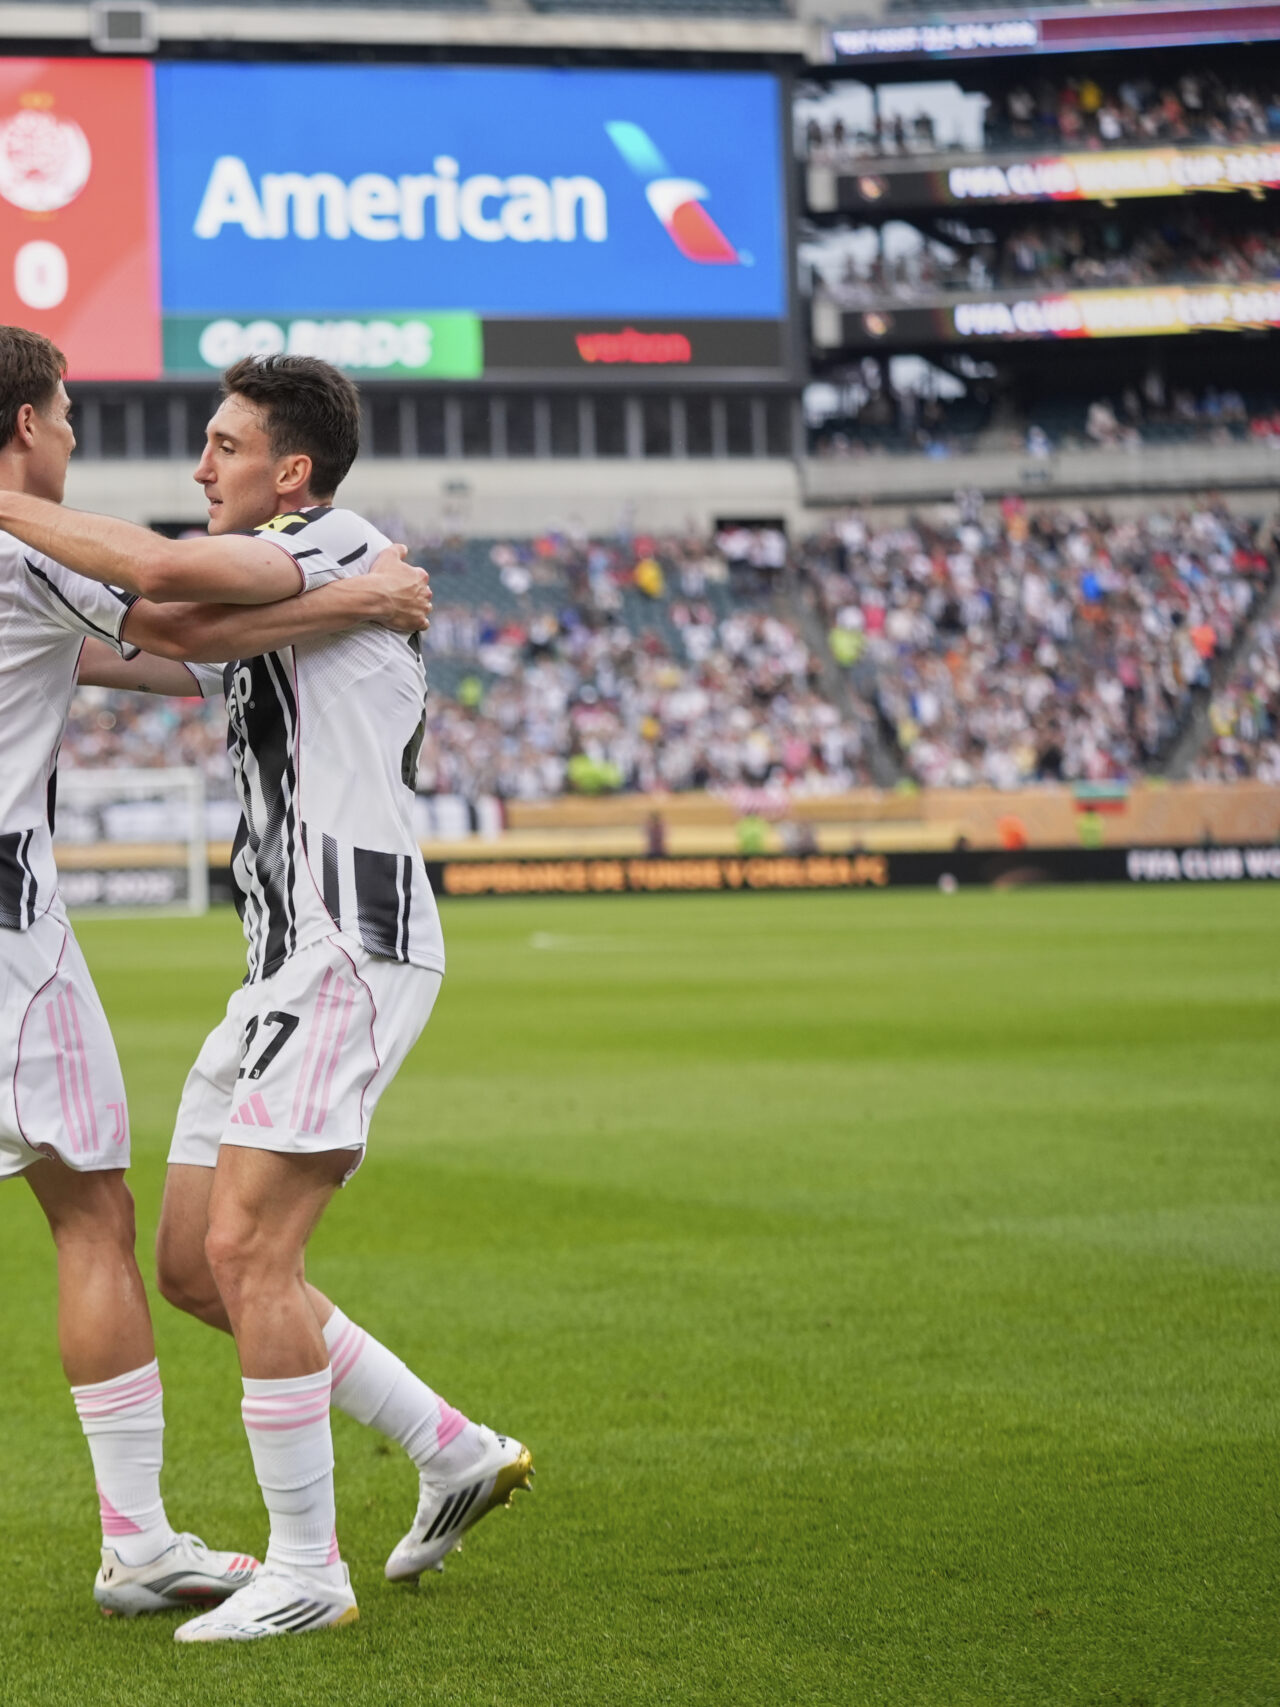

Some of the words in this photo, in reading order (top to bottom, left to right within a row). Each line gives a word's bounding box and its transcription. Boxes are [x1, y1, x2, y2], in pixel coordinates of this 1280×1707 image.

[194, 155, 608, 242] American
[14, 240, 68, 310] 0
[1127, 849, 1181, 881] FIFA
[1182, 848, 1244, 880] CLUB
[238, 1011, 300, 1079] 27
